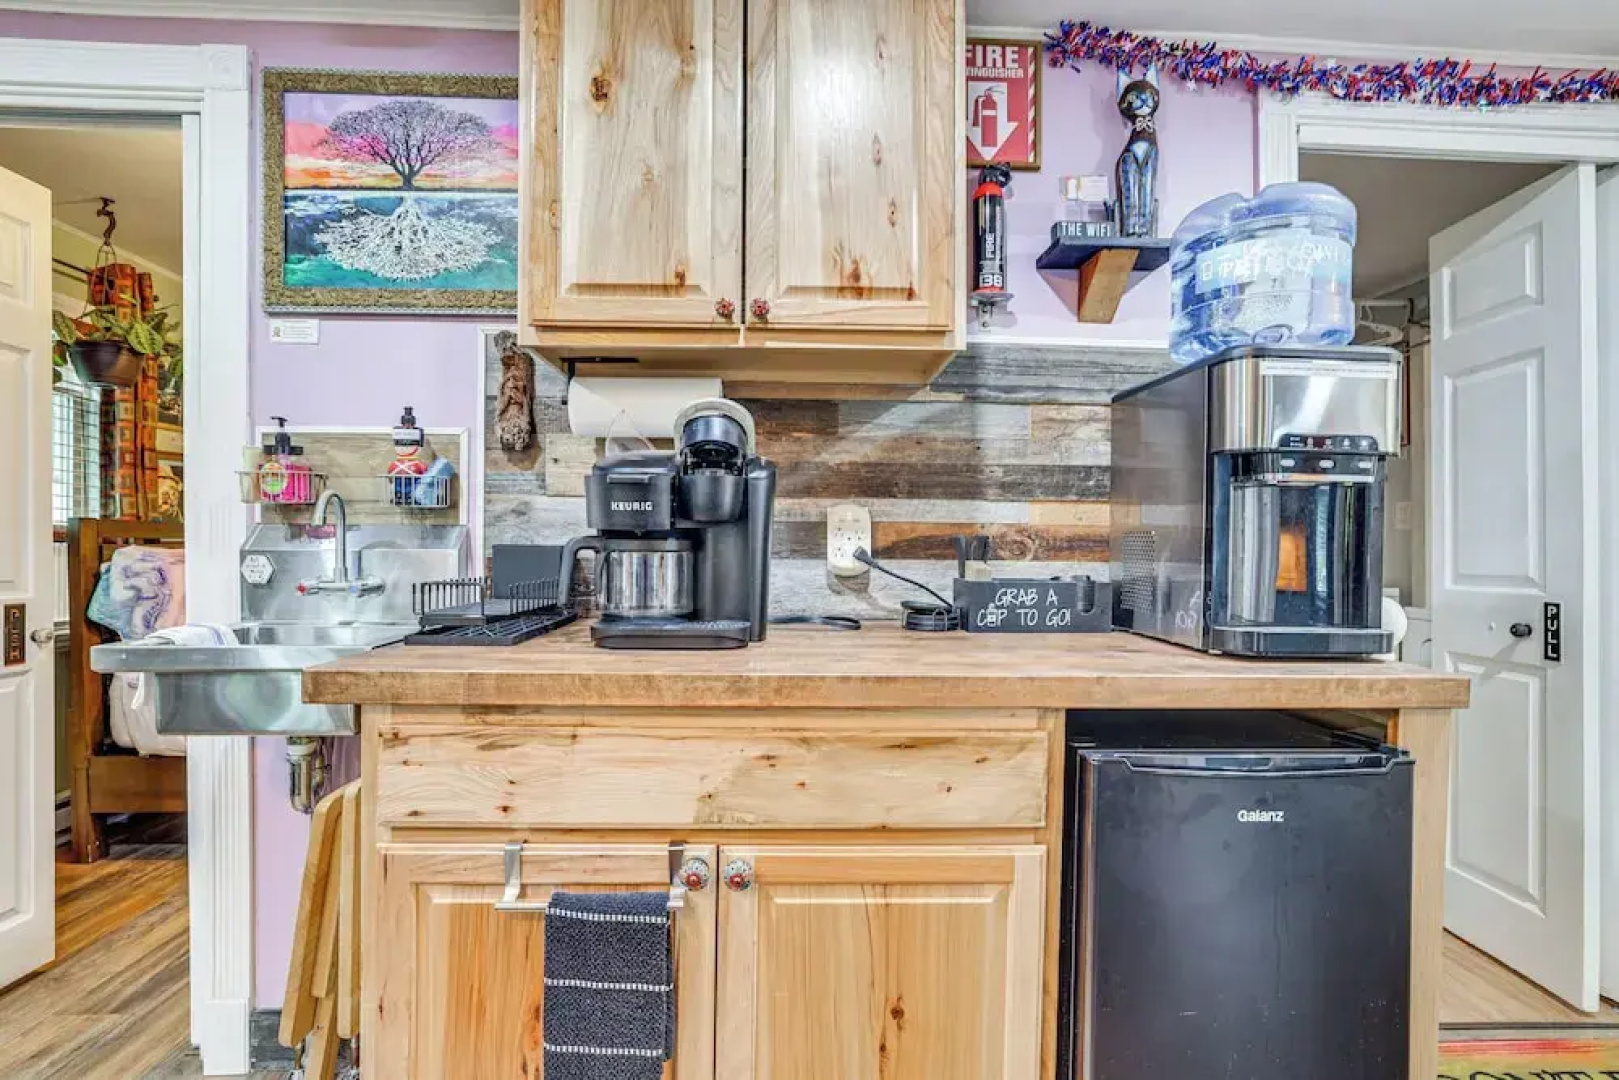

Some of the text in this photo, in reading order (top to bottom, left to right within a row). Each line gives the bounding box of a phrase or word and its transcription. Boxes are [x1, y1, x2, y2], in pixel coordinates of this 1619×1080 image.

[966, 67, 1024, 78] TINGUISHER
[1061, 223, 1110, 237] THE WIFI
[611, 501, 653, 511] KEURIG
[996, 588, 1058, 607] GRAB A
[1015, 608, 1038, 626] TO
[1547, 605, 1557, 658] PULL
[1237, 809, 1284, 822] Galanz
